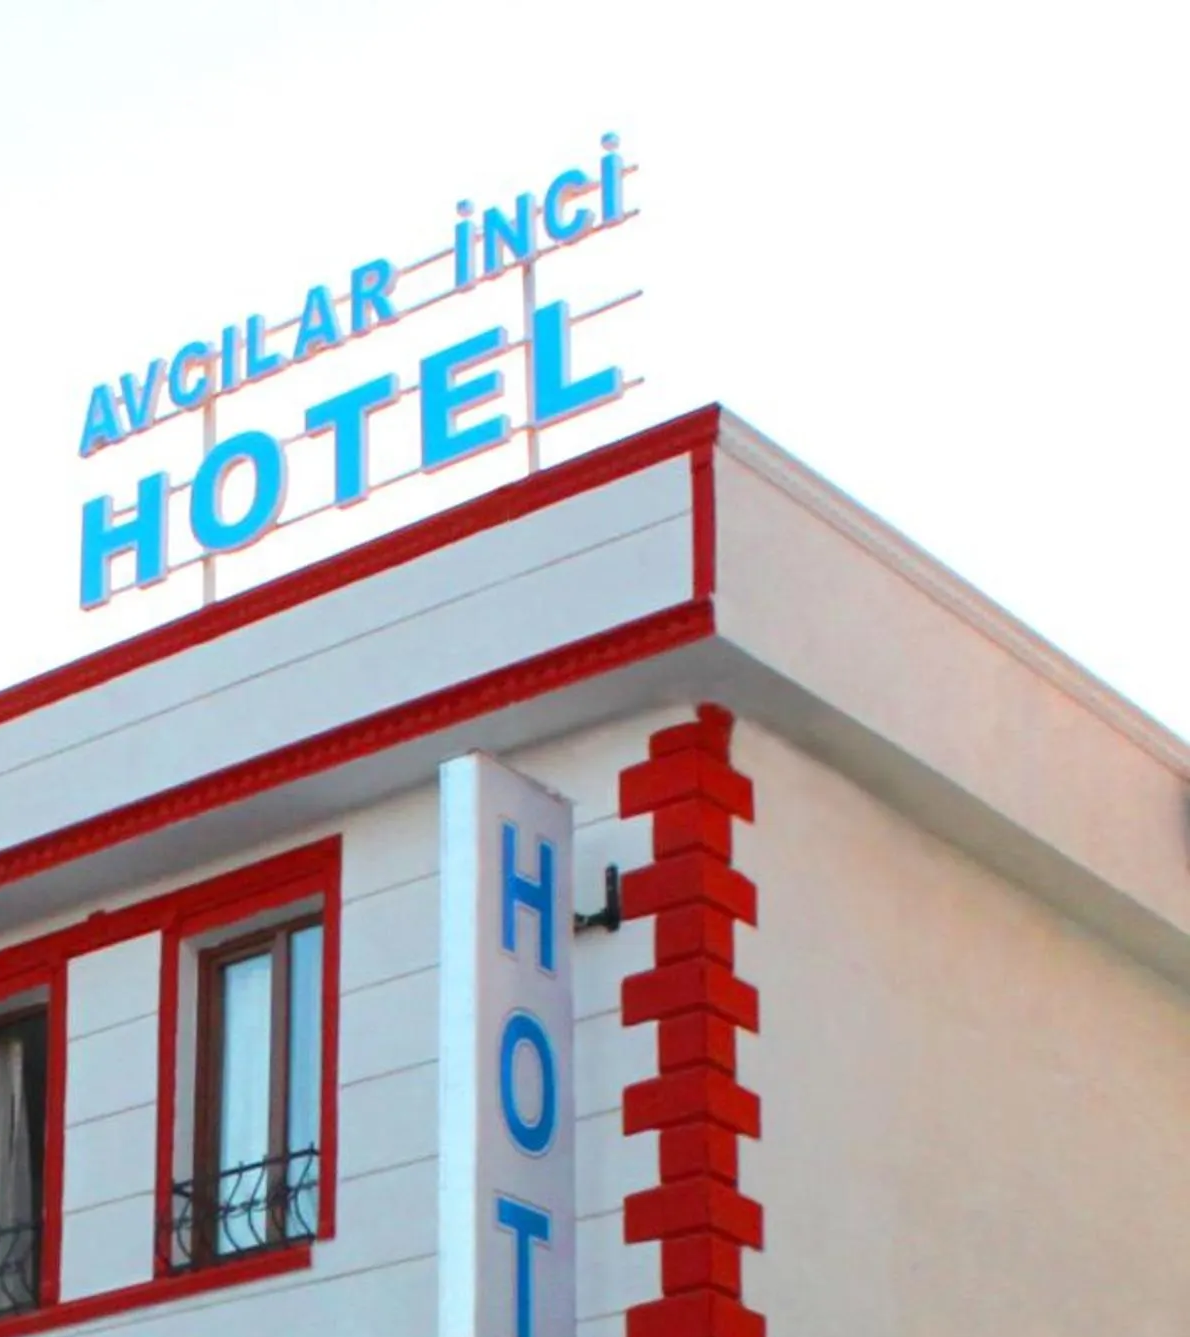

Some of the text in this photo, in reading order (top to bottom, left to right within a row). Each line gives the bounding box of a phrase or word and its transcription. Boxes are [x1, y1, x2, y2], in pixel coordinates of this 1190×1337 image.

[79, 132, 622, 457] AVCILAR İNCİ
[79, 300, 624, 610] HOTEL
